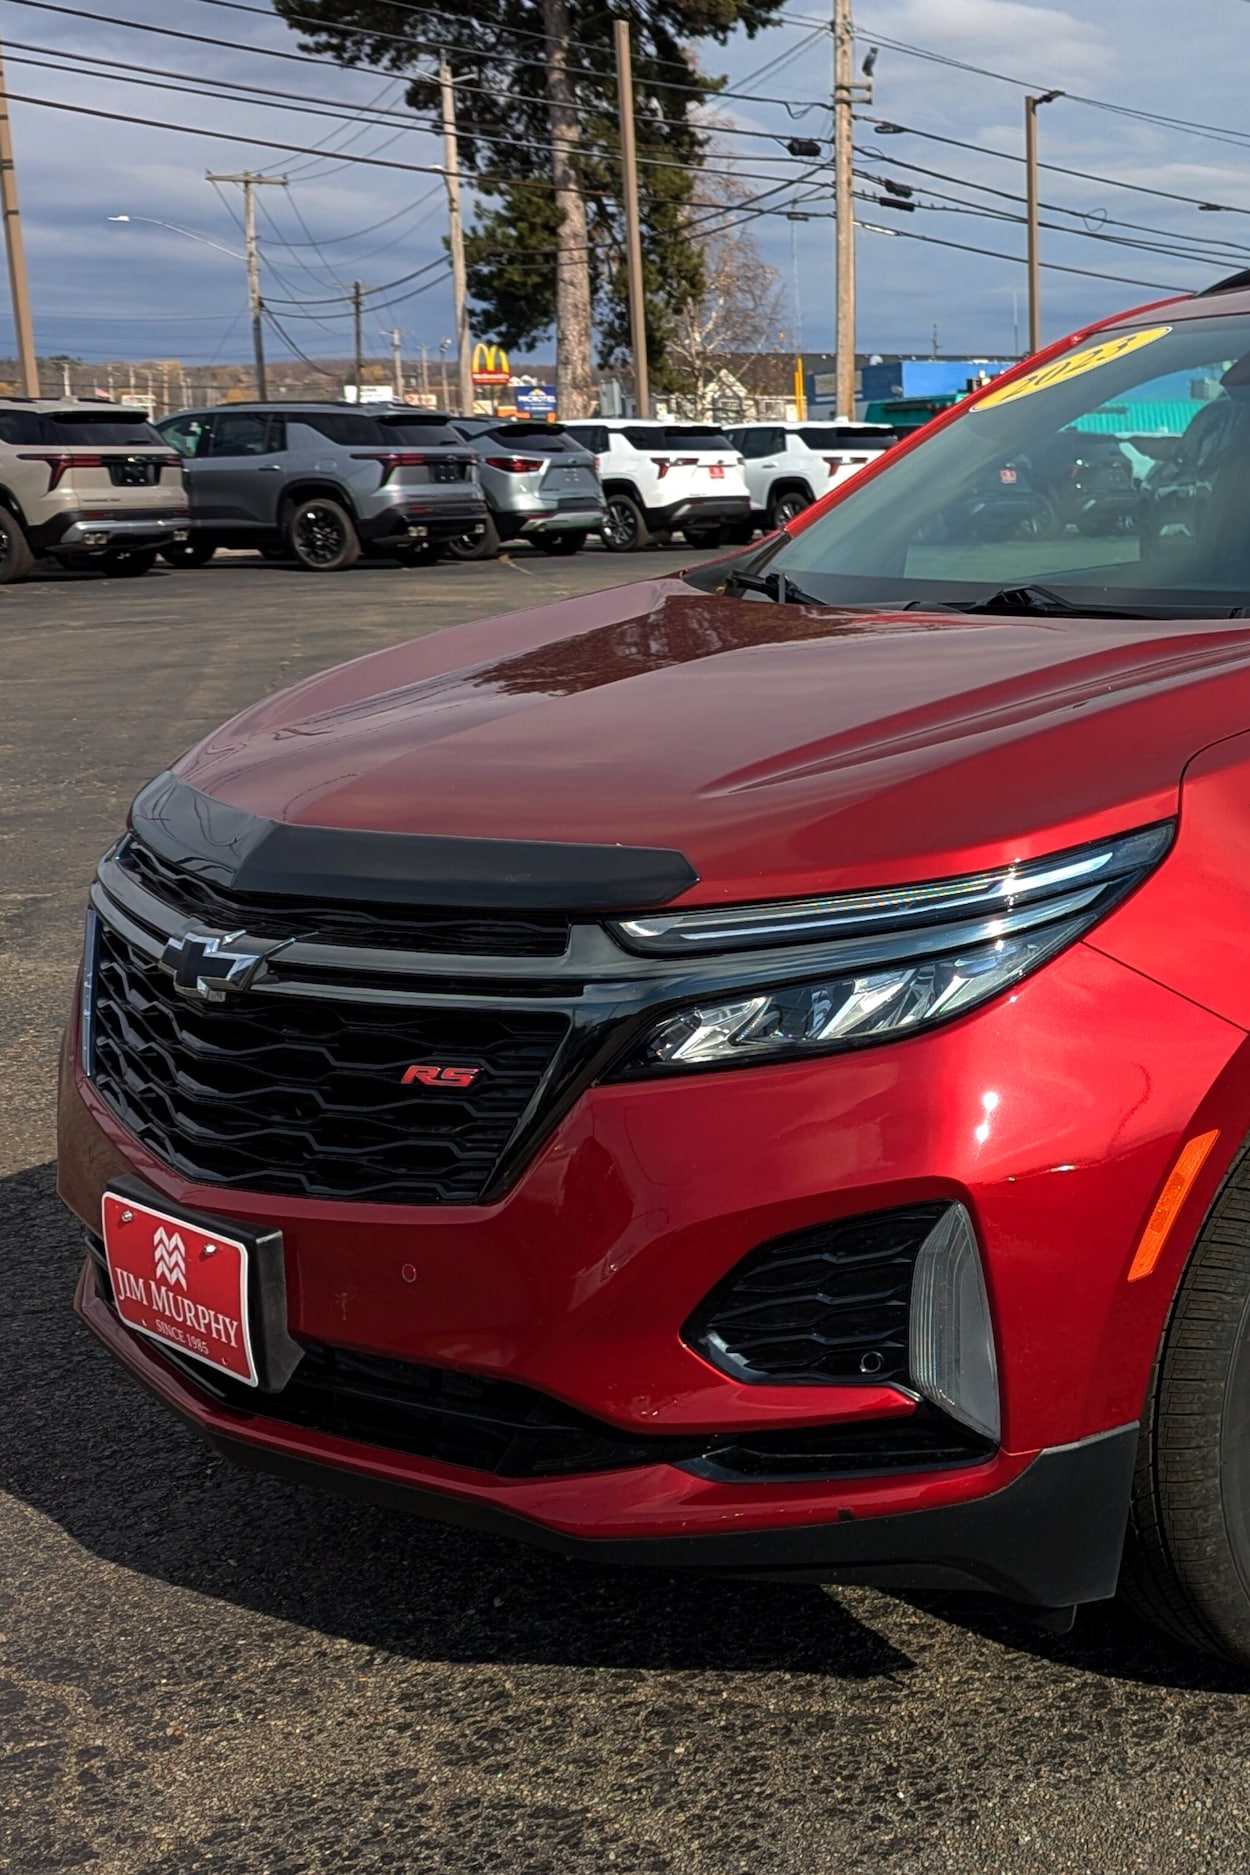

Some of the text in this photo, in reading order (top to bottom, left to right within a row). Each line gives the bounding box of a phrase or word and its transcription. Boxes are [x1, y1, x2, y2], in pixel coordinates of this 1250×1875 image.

[1000, 335, 1138, 401] 2023
[401, 1065, 480, 1087] RS
[115, 1267, 238, 1348] JIM MURPHY
[155, 1319, 209, 1355] SINCE 1985
